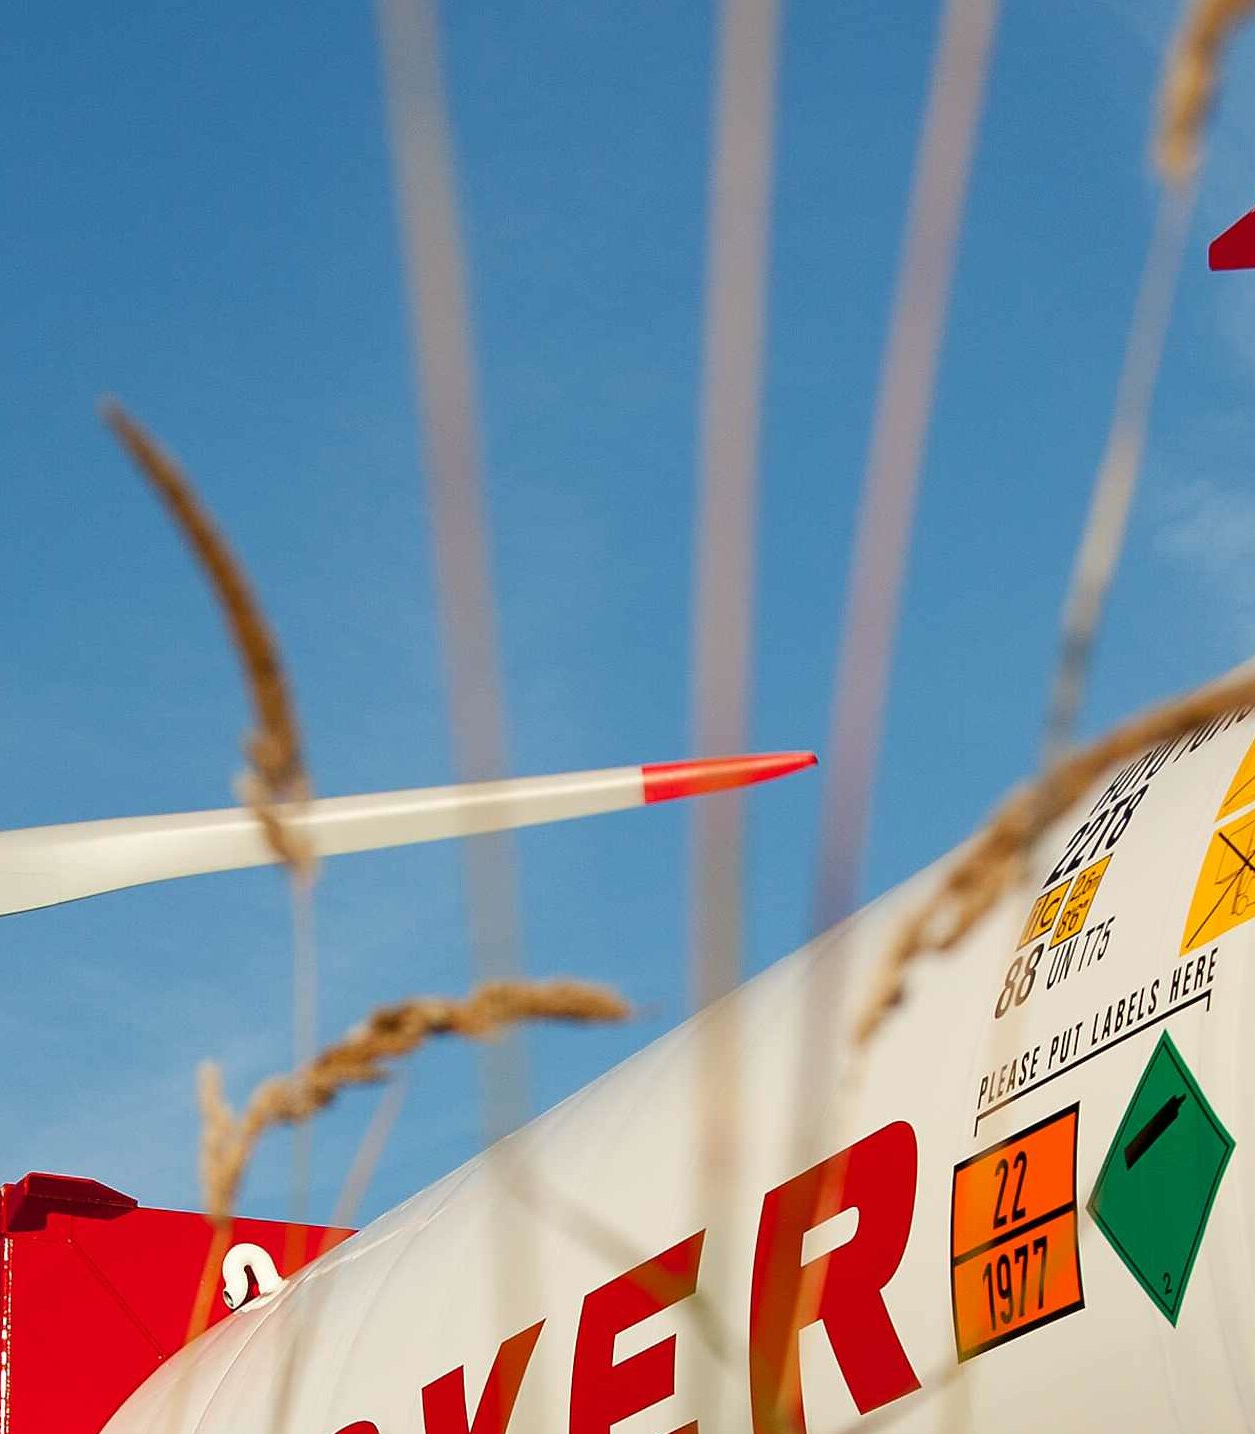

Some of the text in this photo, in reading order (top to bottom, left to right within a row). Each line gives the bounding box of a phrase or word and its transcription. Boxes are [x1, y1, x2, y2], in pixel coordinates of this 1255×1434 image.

[1042, 783, 1149, 889] 22T8
[995, 943, 1045, 1018] 88
[1047, 916, 1116, 990] UN T75
[977, 947, 1219, 1110] PLEASE PUT LABELS HERE
[993, 1151, 1028, 1230] 22
[982, 1235, 1049, 1331] 1977
[1162, 1272, 1173, 1295] 2
